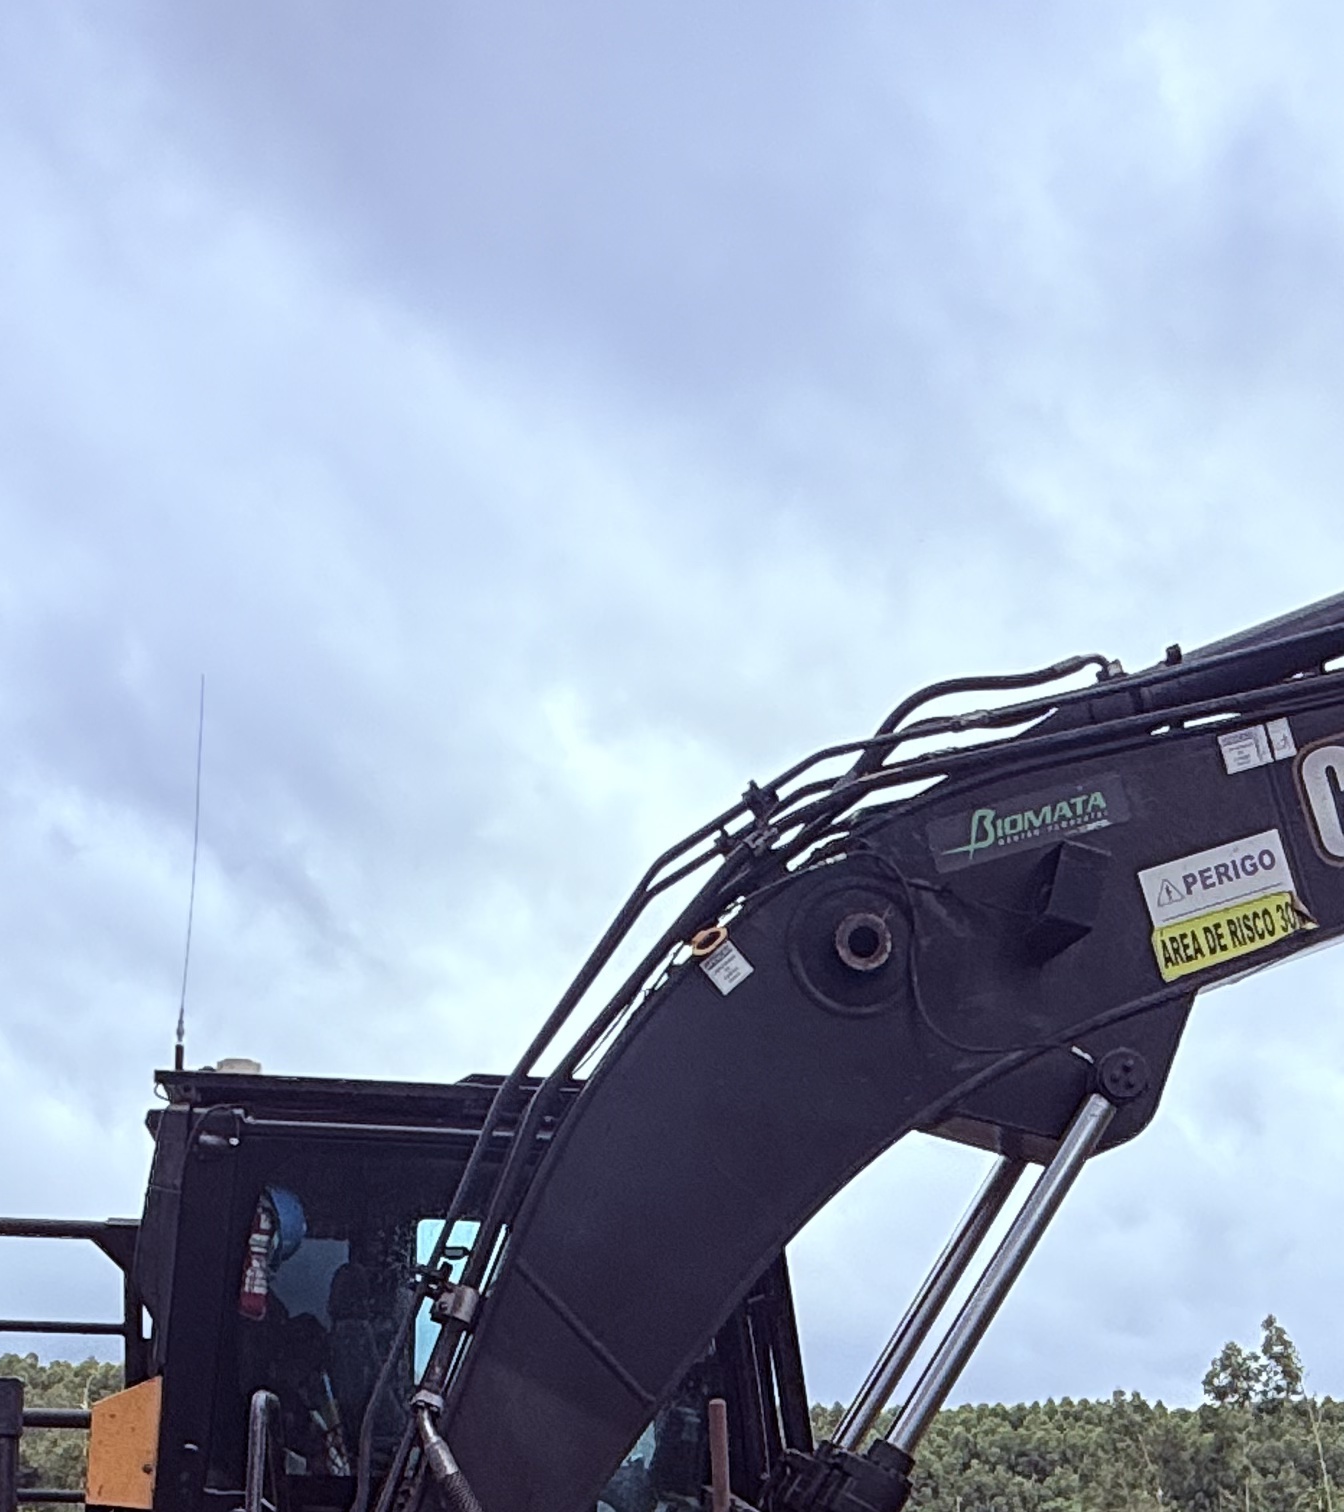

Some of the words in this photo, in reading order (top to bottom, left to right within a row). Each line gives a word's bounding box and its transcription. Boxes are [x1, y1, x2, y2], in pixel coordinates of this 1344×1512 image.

[941, 791, 1107, 860] BIOMATA
[1182, 849, 1276, 896] PERIGO
[1202, 921, 1228, 955] DE
[1226, 907, 1275, 949] RISCO
